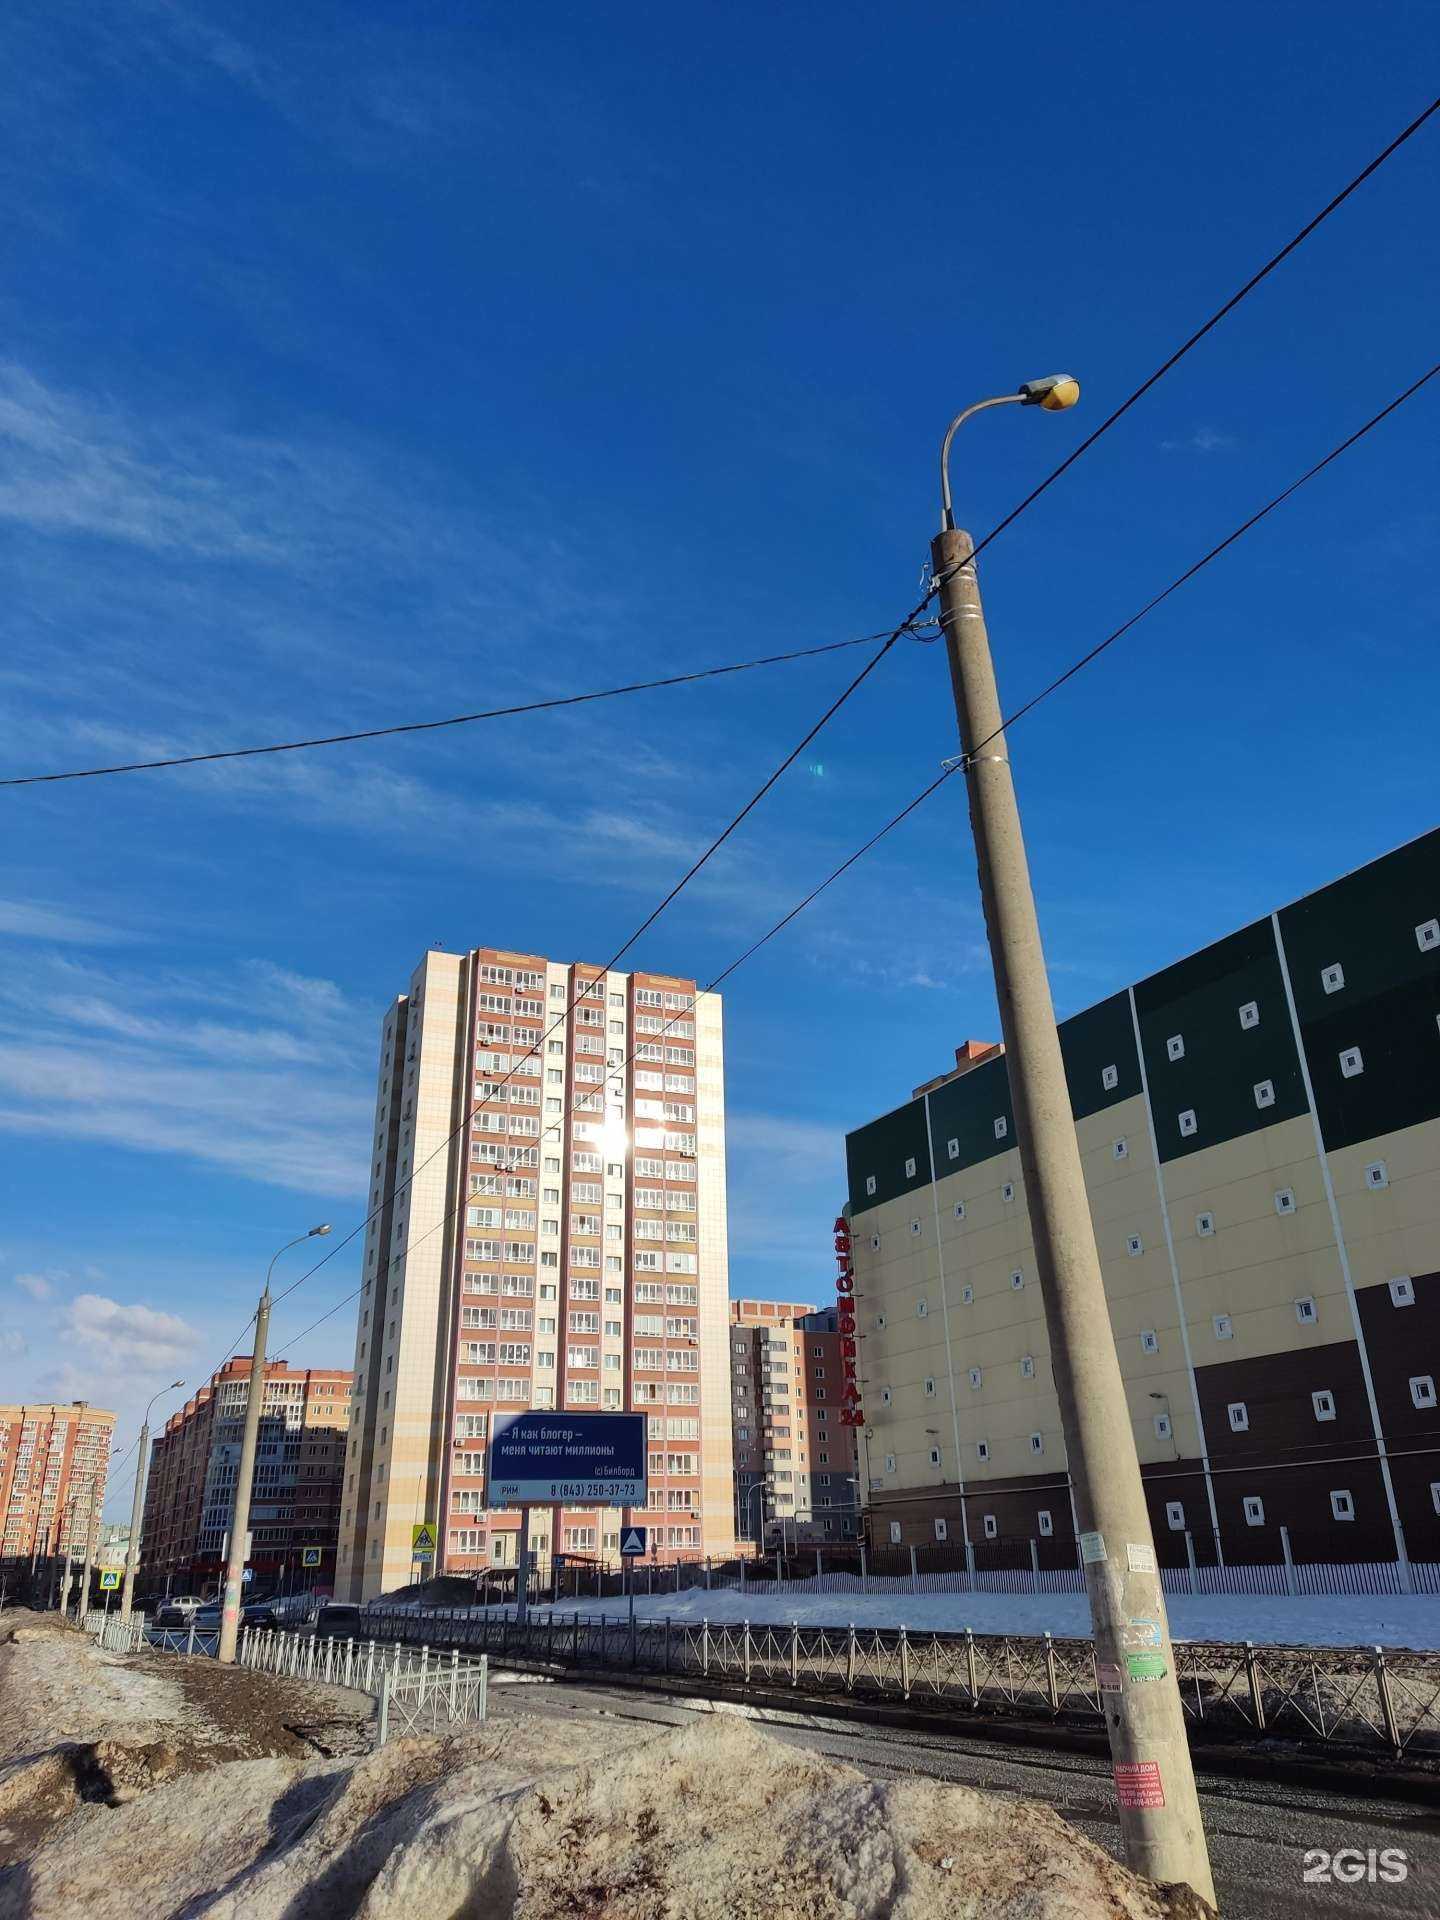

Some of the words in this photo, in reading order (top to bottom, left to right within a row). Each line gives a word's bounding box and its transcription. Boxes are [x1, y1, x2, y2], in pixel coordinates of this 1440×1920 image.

[512, 1427, 519, 1440] Я
[521, 1429, 538, 1440] как
[540, 1427, 573, 1442] блогер
[501, 1446, 526, 1456] меня
[528, 1446, 562, 1456] читают
[565, 1446, 615, 1456] миллионы
[501, 1486, 519, 1495] РИМ
[551, 1485, 556, 1496] 8
[559, 1484, 585, 1497] (843)
[587, 1484, 636, 1496] 250-37-73
[1140, 1763, 1157, 1773] ДОМ
